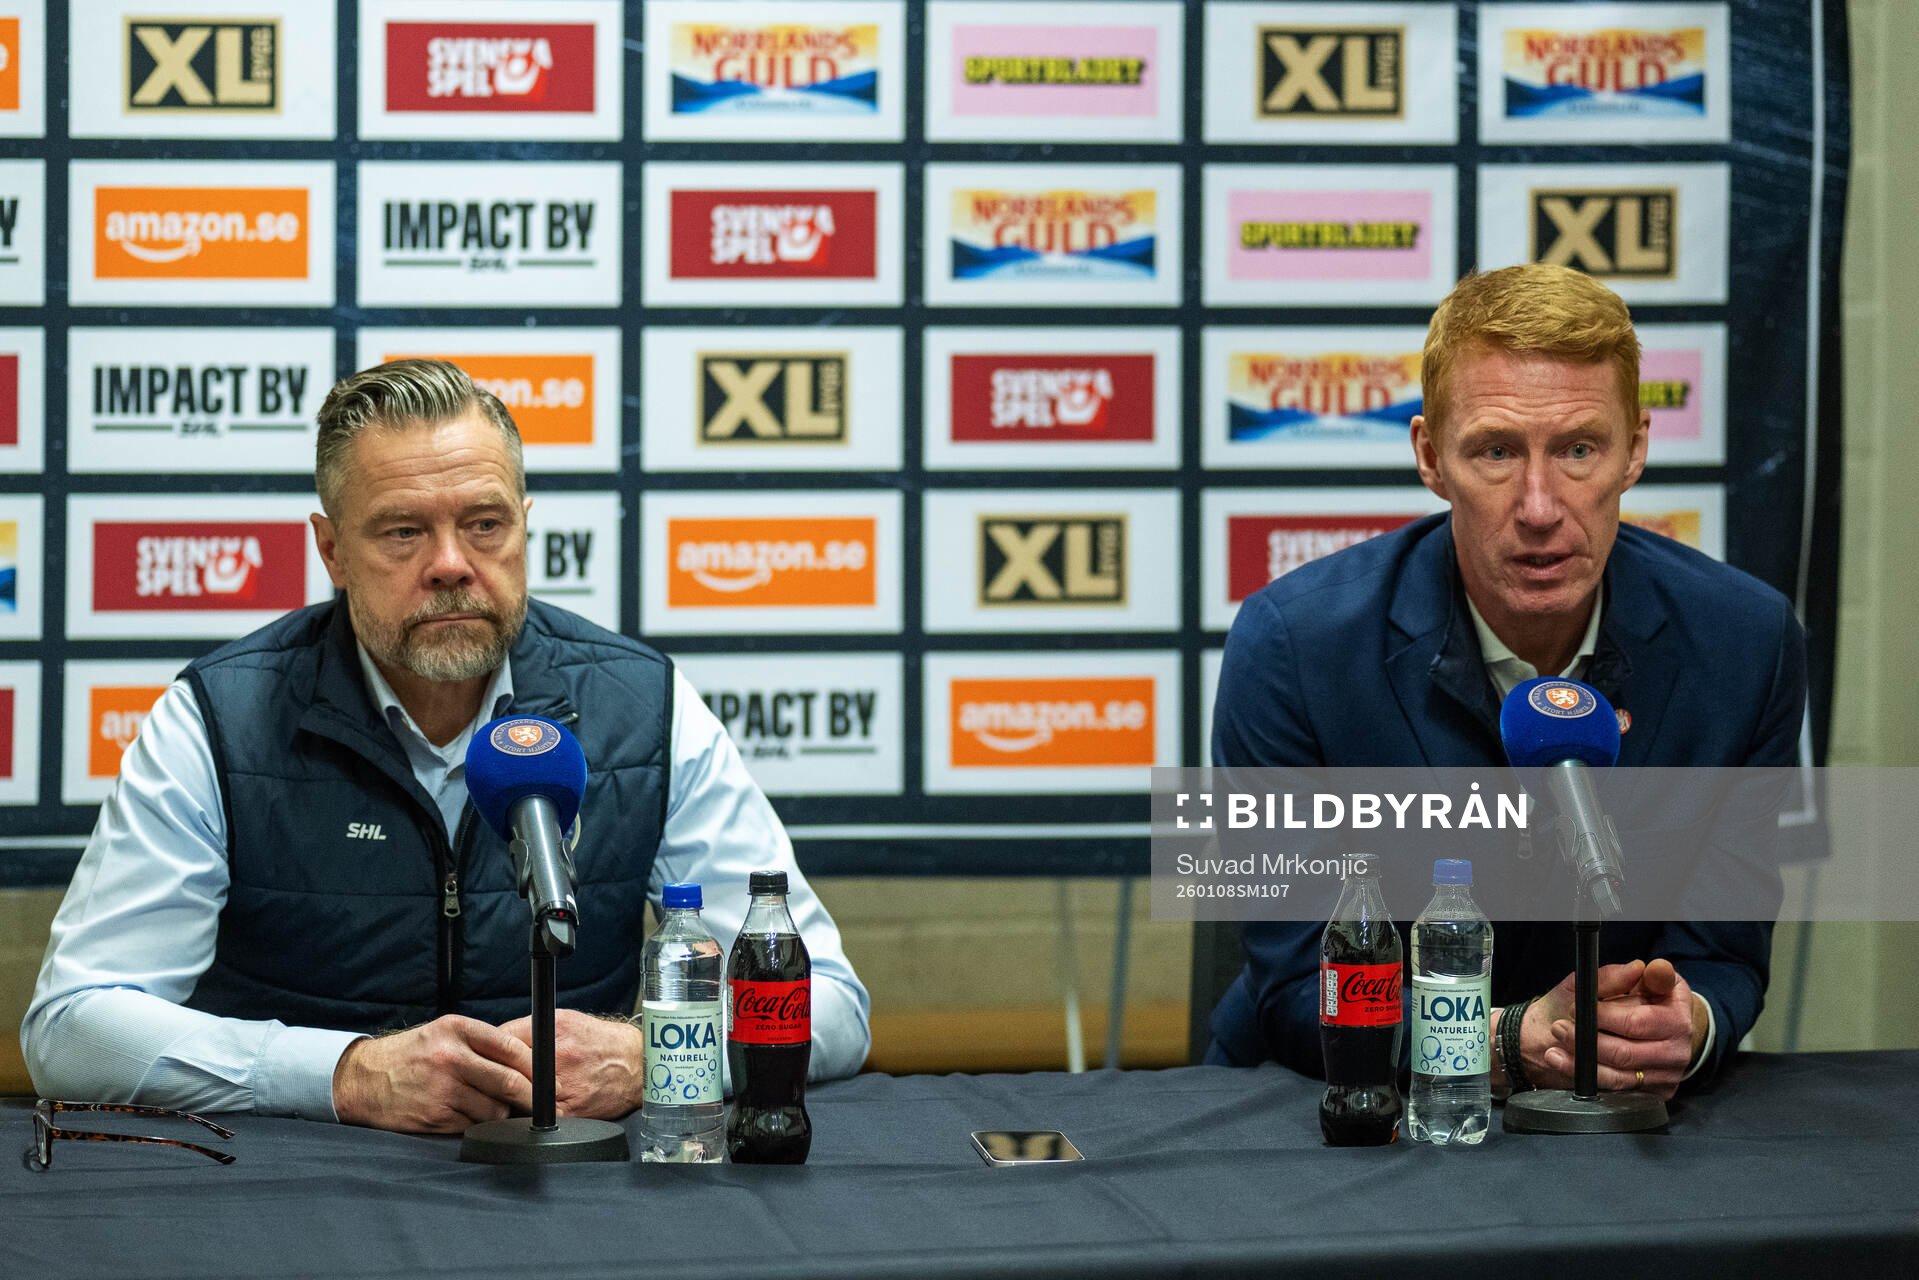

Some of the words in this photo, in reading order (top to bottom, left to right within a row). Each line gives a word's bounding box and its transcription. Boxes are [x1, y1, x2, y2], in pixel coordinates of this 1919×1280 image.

[132, 26, 273, 104] XL
[426, 67, 493, 97] SPEL
[713, 53, 838, 89] GULD
[1266, 35, 1395, 110] XL
[1545, 58, 1668, 93] GULD
[105, 211, 299, 242] amazon.se
[384, 203, 535, 249] IMPACT
[547, 203, 595, 249] BY
[992, 220, 1117, 255] GULD
[1539, 197, 1667, 271] XL
[711, 234, 775, 264] SPEL
[94, 366, 248, 415] IMPACT
[259, 366, 308, 415] BY
[706, 361, 840, 437] XL
[1268, 383, 1392, 417] GULD
[991, 397, 1055, 428] SPEL
[545, 531, 592, 579] BY
[677, 540, 867, 571] amazon.se
[986, 523, 1118, 598] XL
[136, 565, 202, 597] SPEL
[701, 691, 818, 740] PACT
[829, 691, 876, 738] BY
[959, 700, 1147, 731] amazon.se
[346, 822, 387, 840] SHL
[1420, 995, 1485, 1022] LOKA
[650, 1022, 717, 1050] LOKA
[1430, 1026, 1477, 1034] NATURELL
[660, 1054, 708, 1063] NATURELL
